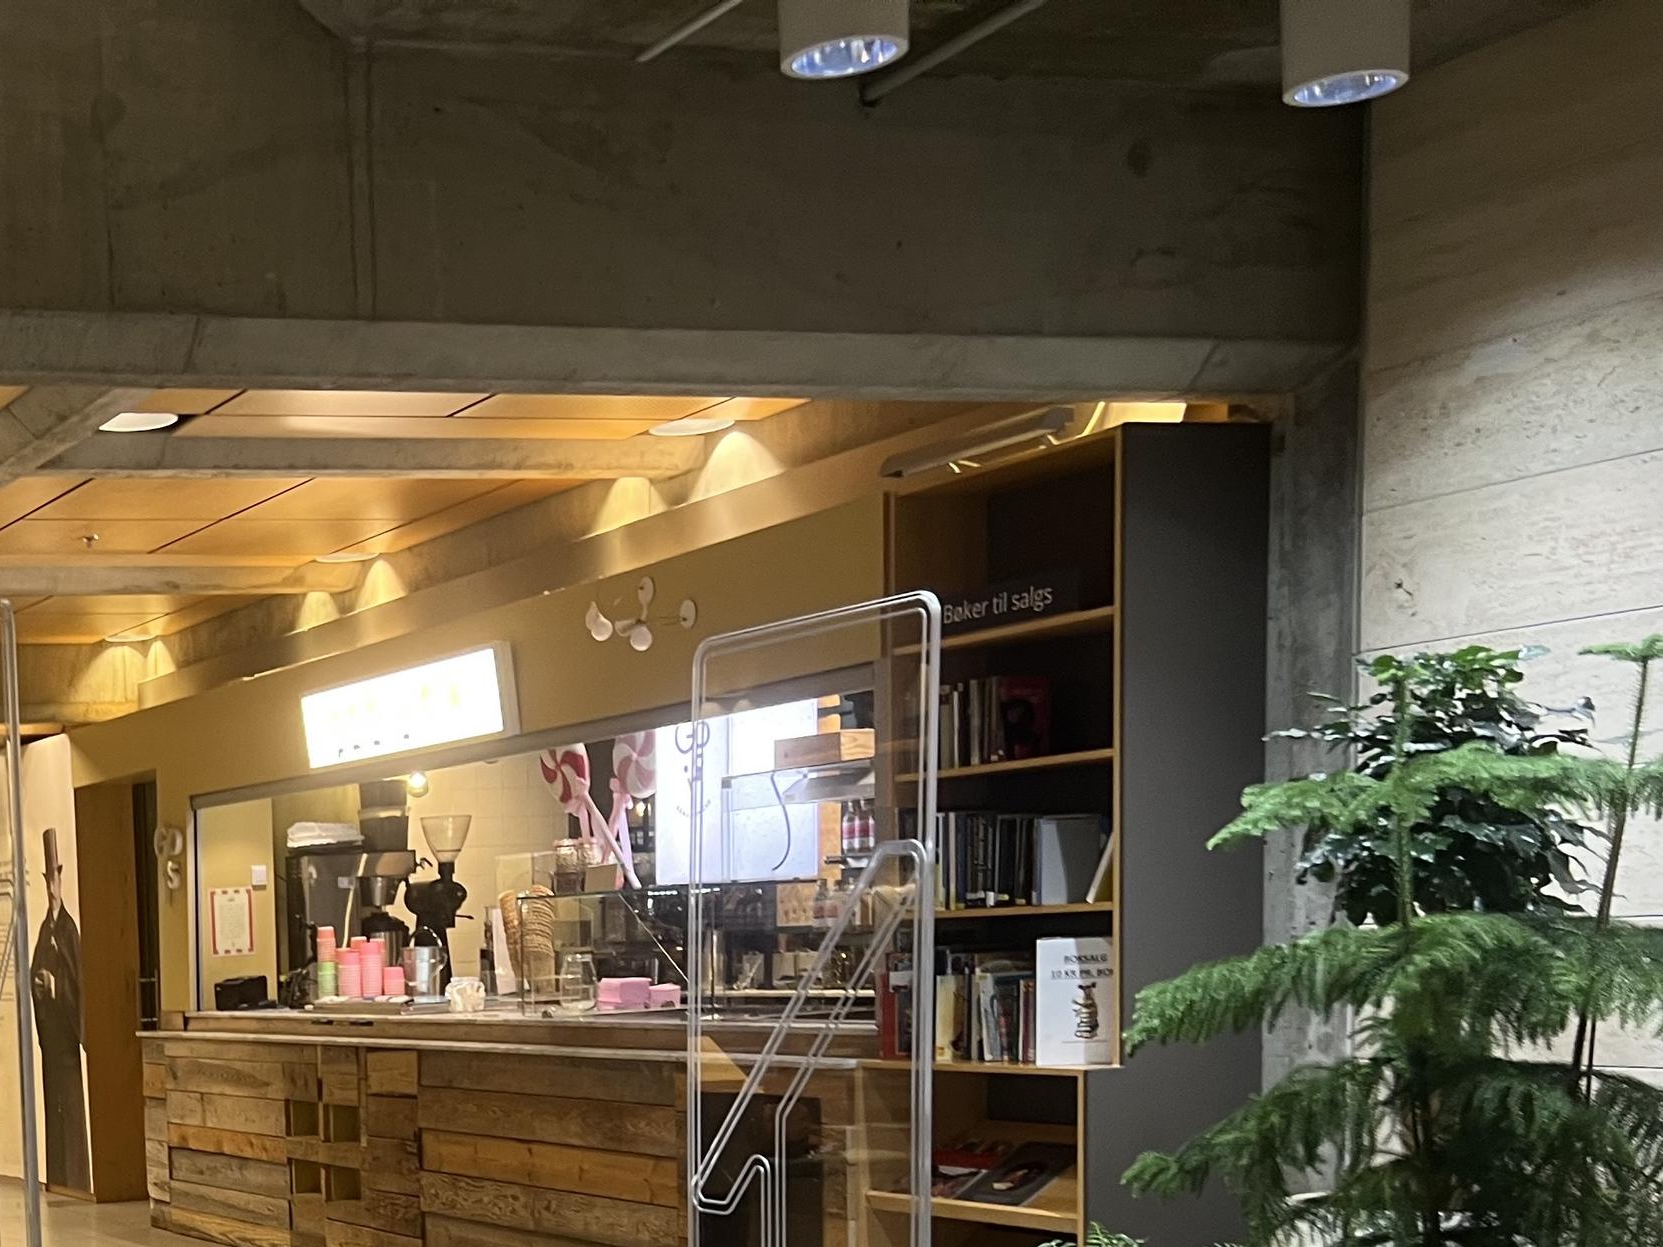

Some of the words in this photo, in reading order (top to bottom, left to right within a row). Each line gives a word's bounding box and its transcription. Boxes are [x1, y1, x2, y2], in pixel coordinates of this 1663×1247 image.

[943, 600, 989, 624] Bøker
[992, 592, 1008, 614] til
[1011, 586, 1054, 612] salgs
